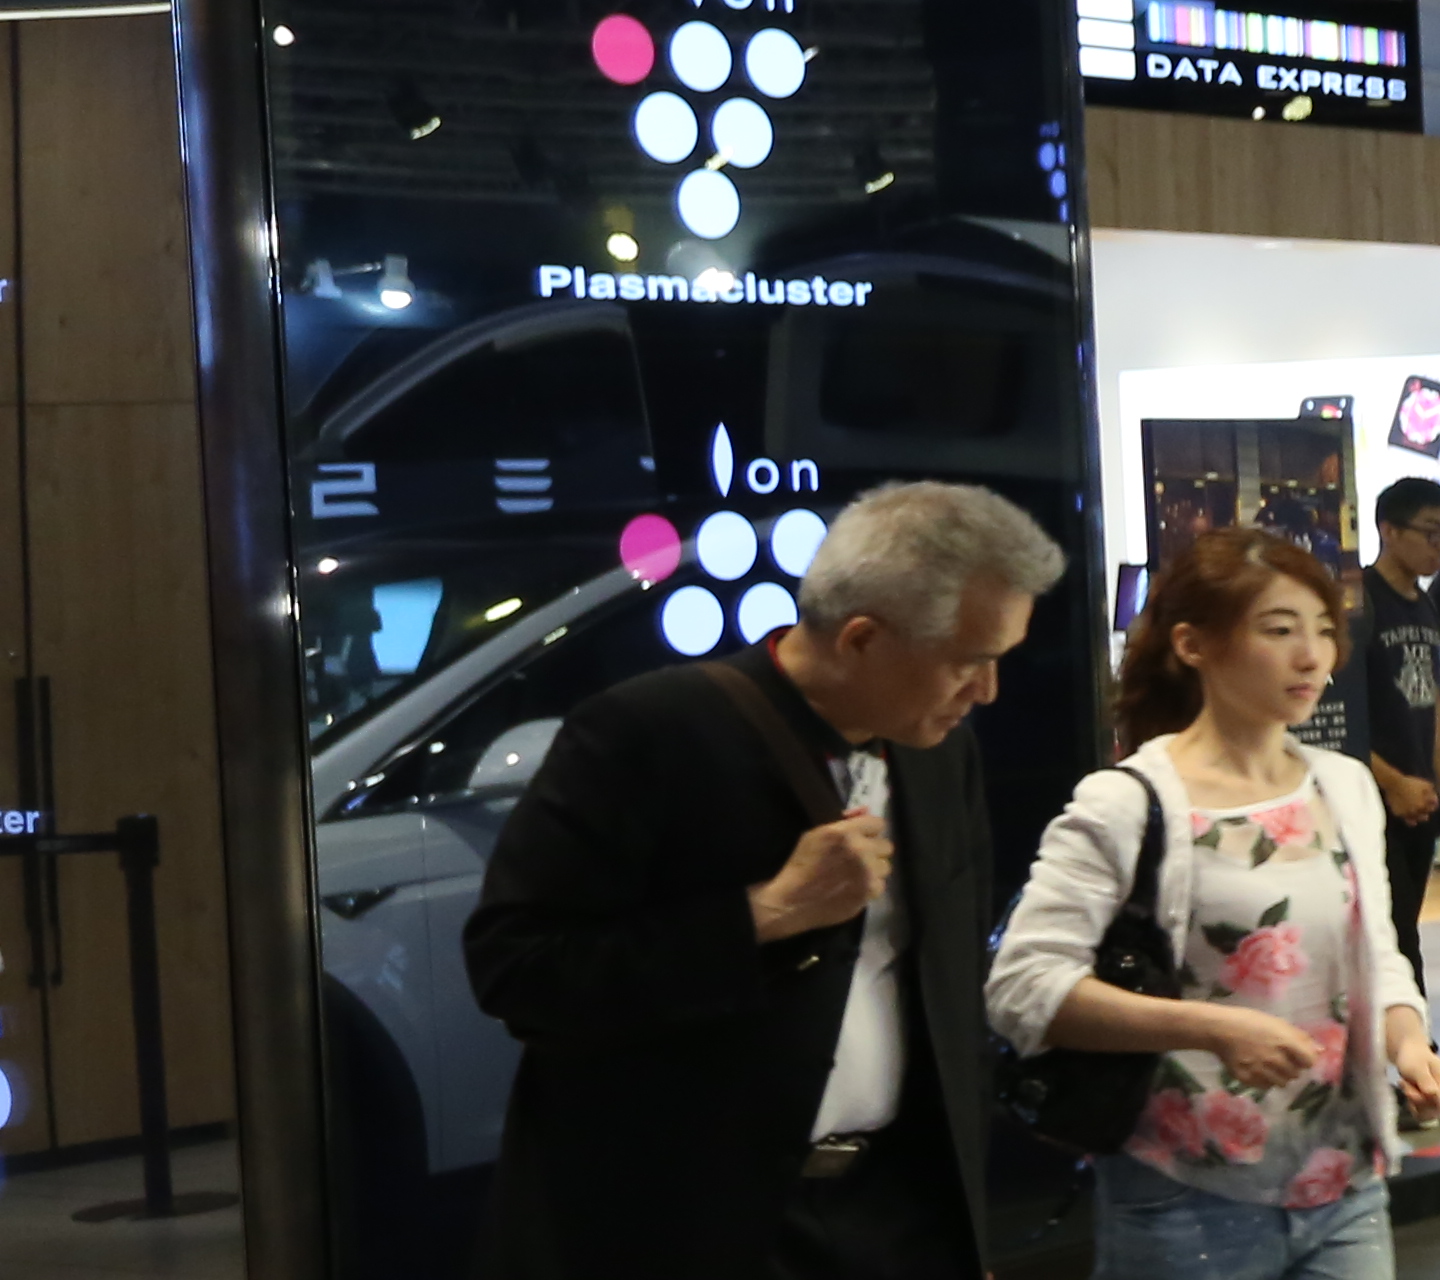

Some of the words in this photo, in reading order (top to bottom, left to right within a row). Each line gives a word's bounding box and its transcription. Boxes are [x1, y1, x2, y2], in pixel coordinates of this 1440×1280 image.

[1146, 53, 1243, 87] DATA
[1256, 64, 1407, 102] EXPRESS
[537, 263, 873, 308] Plasmacluster
[710, 420, 819, 499] Ion
